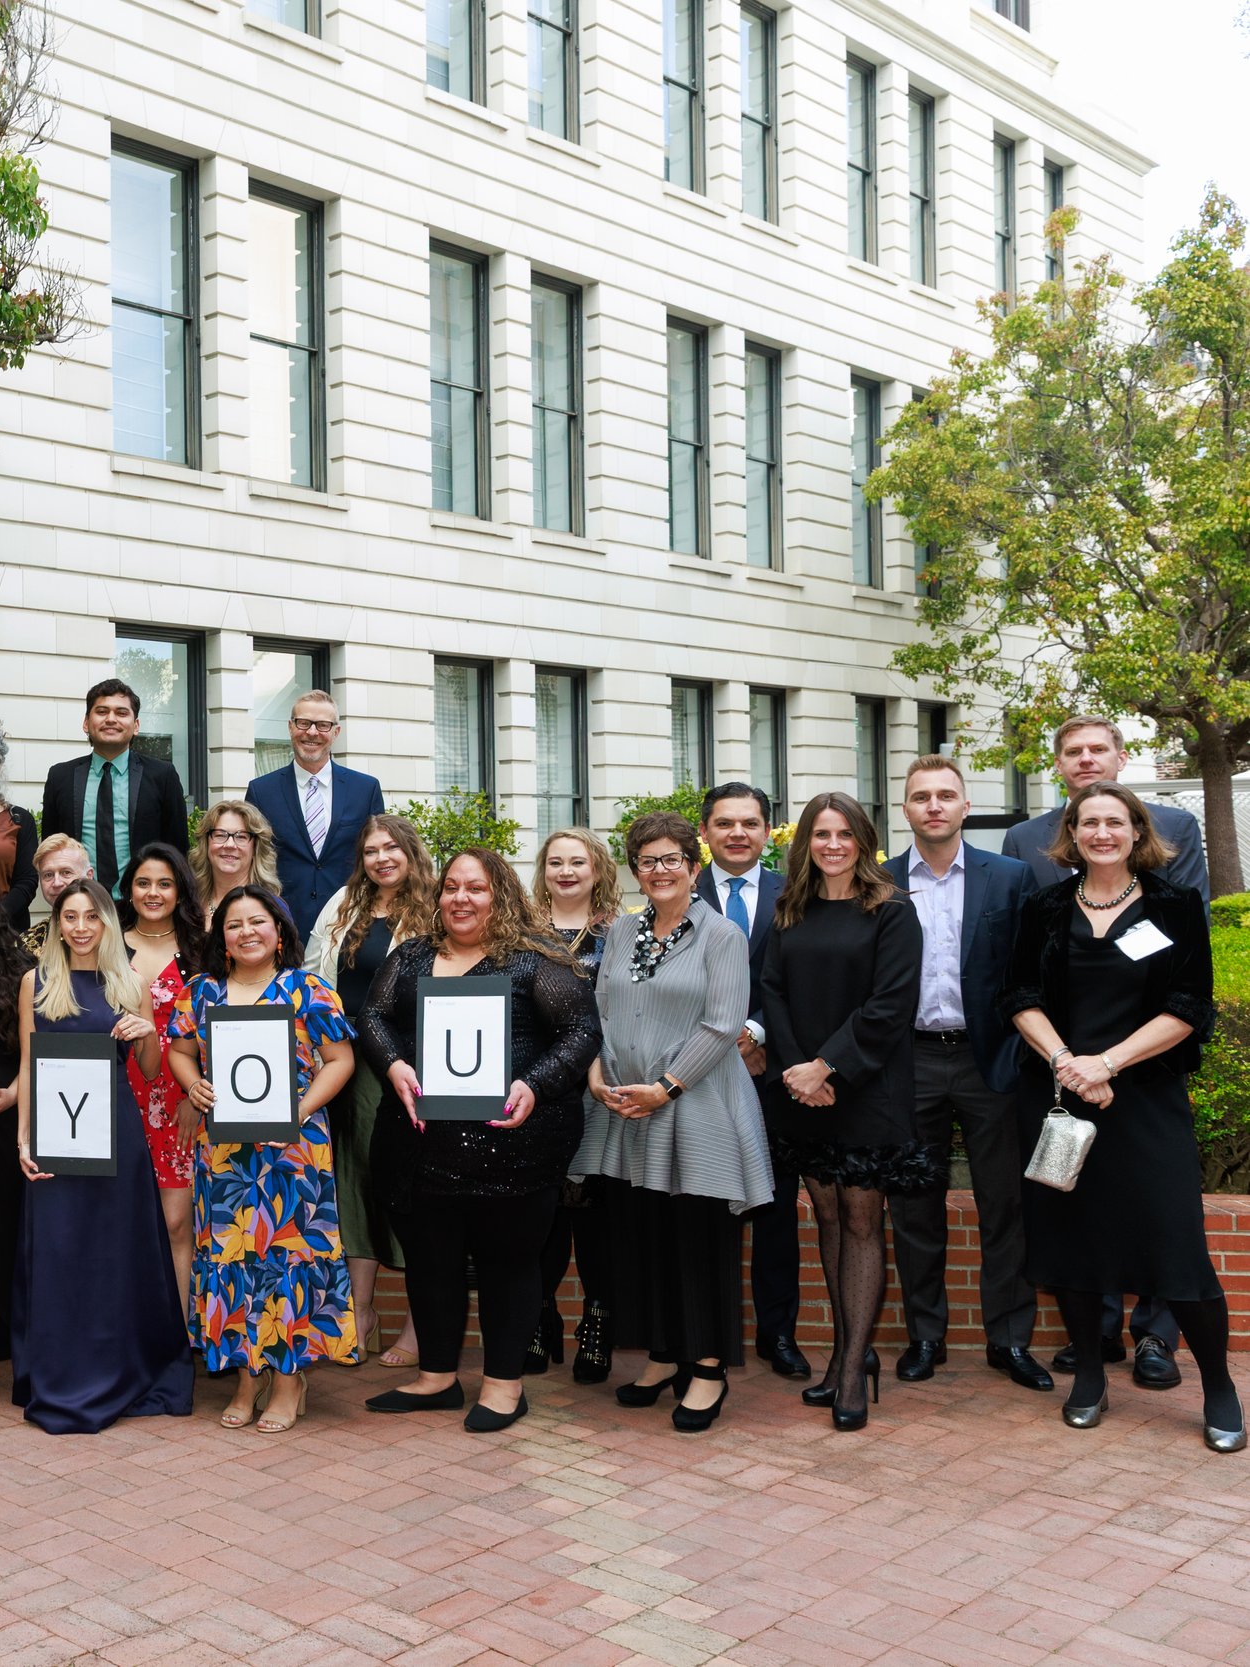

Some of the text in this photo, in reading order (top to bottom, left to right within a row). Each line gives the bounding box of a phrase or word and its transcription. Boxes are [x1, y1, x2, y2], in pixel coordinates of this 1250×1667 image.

[445, 1029, 482, 1078] U
[230, 1054, 272, 1104] O
[58, 1092, 90, 1140] Y
